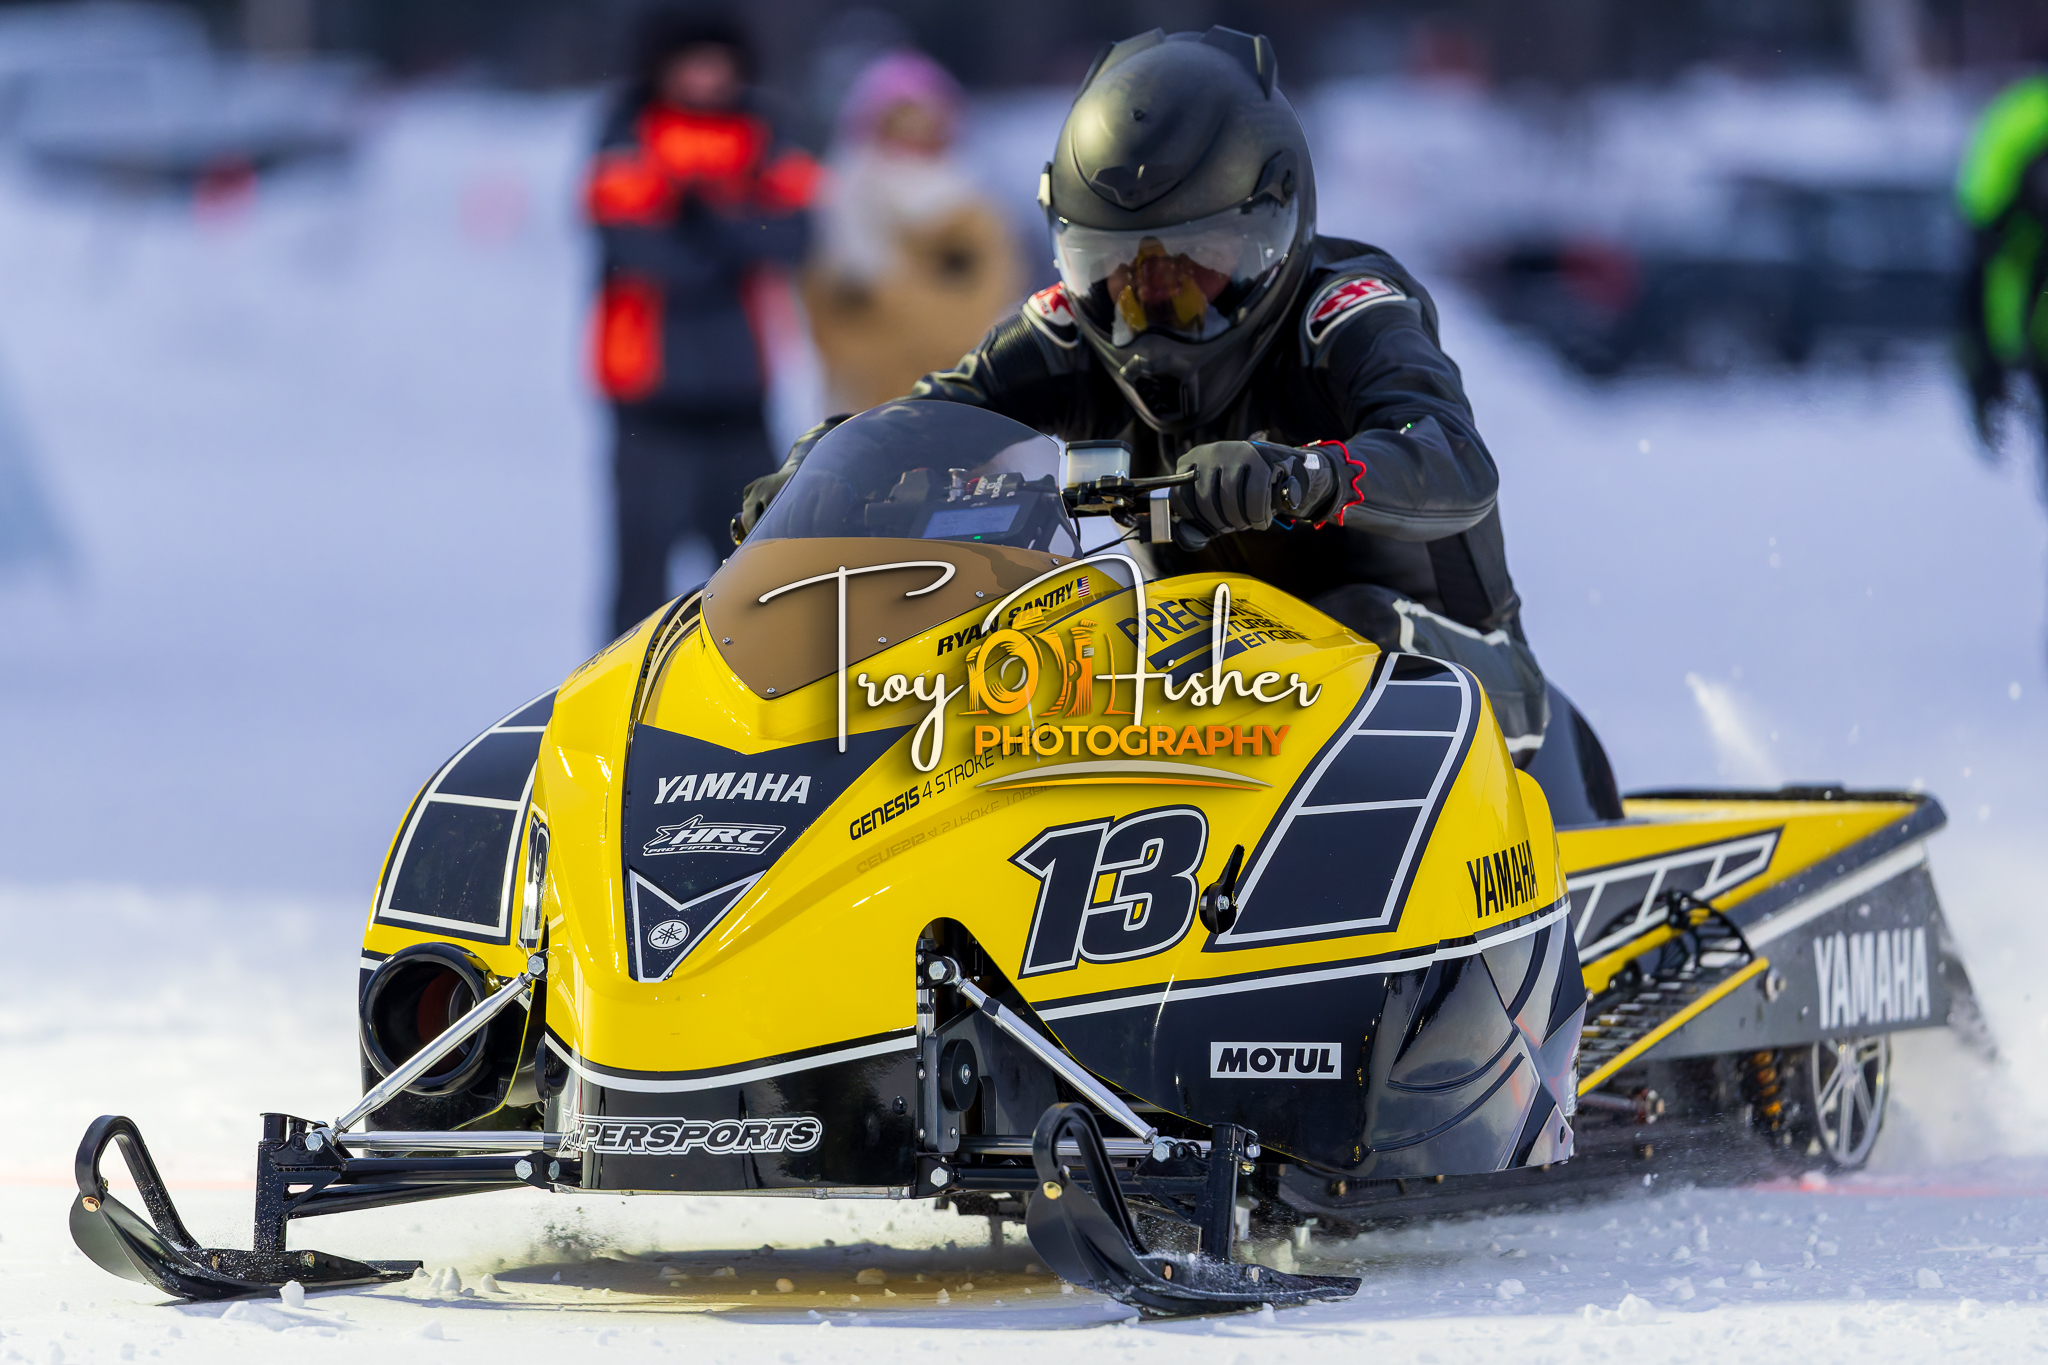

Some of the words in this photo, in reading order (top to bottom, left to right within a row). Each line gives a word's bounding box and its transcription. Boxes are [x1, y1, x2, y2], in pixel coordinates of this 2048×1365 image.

[937, 614, 1000, 657] RYAN
[1008, 580, 1075, 627] SANTRY
[654, 771, 812, 805] YAMAHA
[849, 785, 920, 841] GENESIS
[922, 780, 933, 799] 4
[935, 748, 995, 795] STROKE
[668, 828, 776, 846] HRC
[1007, 804, 1210, 980] 13
[1466, 839, 1539, 919] YAMAHA
[1813, 926, 1931, 1030] YAMAHA
[1216, 1047, 1336, 1074] MOTUL
